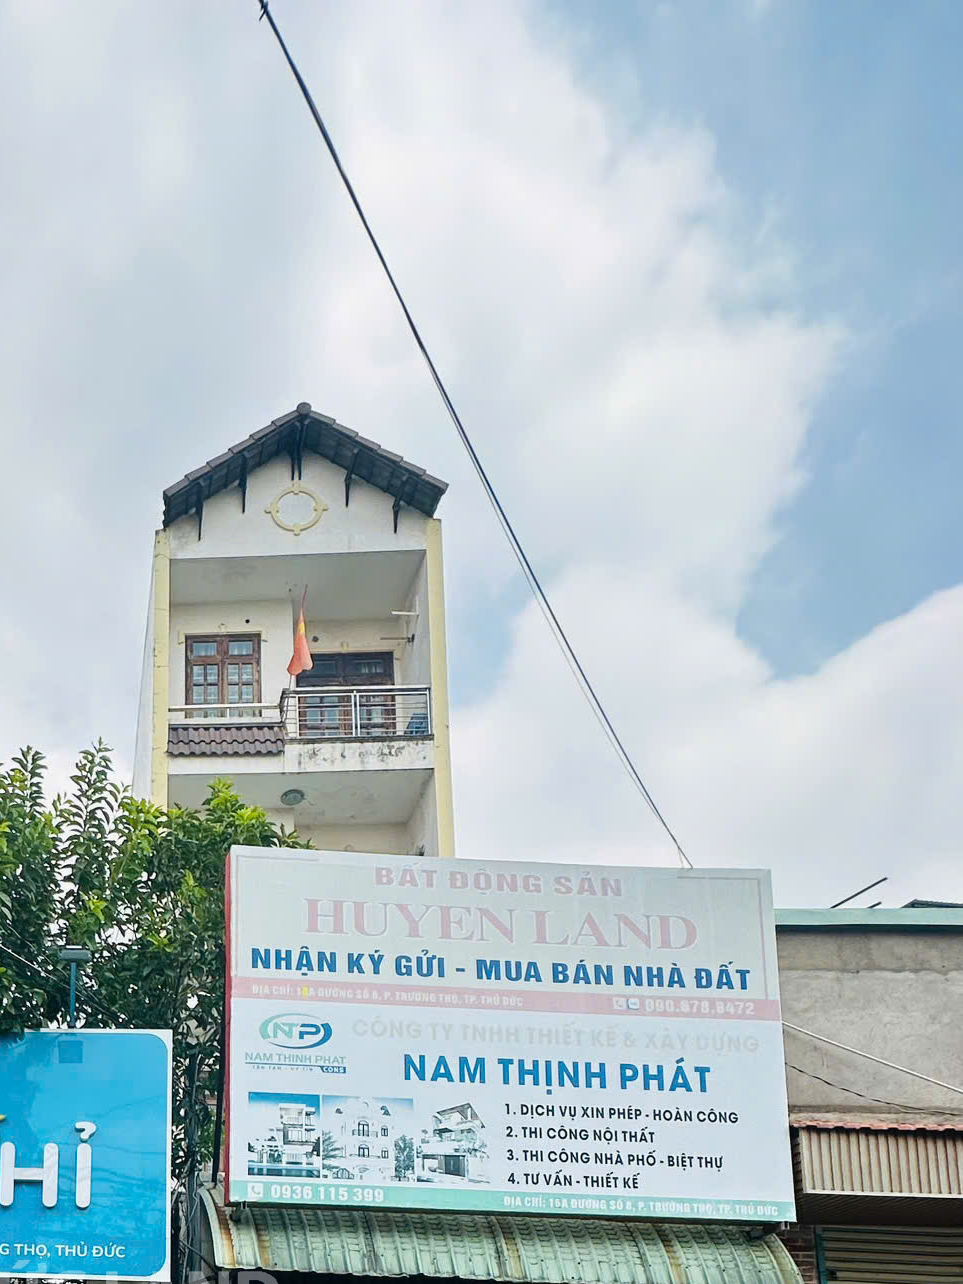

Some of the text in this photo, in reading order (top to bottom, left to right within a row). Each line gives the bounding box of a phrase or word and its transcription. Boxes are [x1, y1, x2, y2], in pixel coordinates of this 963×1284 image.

[375, 863, 622, 897] BẤT ĐỘNG SẢN
[532, 909, 697, 949] LAND
[251, 945, 337, 976] NHẬN
[347, 949, 384, 975] KÝ
[395, 949, 445, 978] GỬI
[476, 959, 542, 982] MUA
[552, 959, 614, 986] BÁN
[624, 962, 685, 988] NHÀ
[694, 961, 750, 990] ĐẤT
[352, 1015, 422, 1039] CÔNG
[428, 1022, 454, 1041] TY
[460, 1024, 519, 1044] TNHH
[526, 1021, 585, 1048] THIẾT
[591, 1024, 616, 1048] KẾ
[623, 1031, 637, 1049] &
[645, 1027, 687, 1051] XÂY
[245, 1051, 273, 1061] NAM
[404, 1054, 711, 1095] NAM THỊNH PHÁT
[504, 1104, 516, 1115] 1.
[520, 1104, 555, 1117] DỊCH
[559, 1106, 577, 1121] VỤ
[581, 1106, 605, 1119] XIN
[609, 1106, 642, 1120] PHÉP
[653, 1108, 693, 1122] HOÀN
[697, 1108, 739, 1124] CÔNG
[506, 1125, 655, 1145] 2. THI CÔNG NỘI THẤT
[507, 1150, 519, 1161] 3.
[523, 1150, 543, 1162] THI
[547, 1148, 590, 1164] CÔNG
[594, 1151, 624, 1166] NHÀ
[627, 1150, 657, 1167] PHỐ
[667, 1155, 694, 1171] BIỆT
[697, 1155, 724, 1172] THỰ
[507, 1173, 519, 1185] 4.
[523, 1172, 540, 1185] TƯ
[543, 1169, 573, 1186] VẤN
[583, 1172, 619, 1188] THIẾT
[623, 1173, 641, 1189] KẾ
[271, 1184, 384, 1202] 0936 115 399
[13, 1243, 51, 1259] THỌ,
[55, 1240, 88, 1257] THỦ
[92, 1242, 126, 1258] ĐỨC
